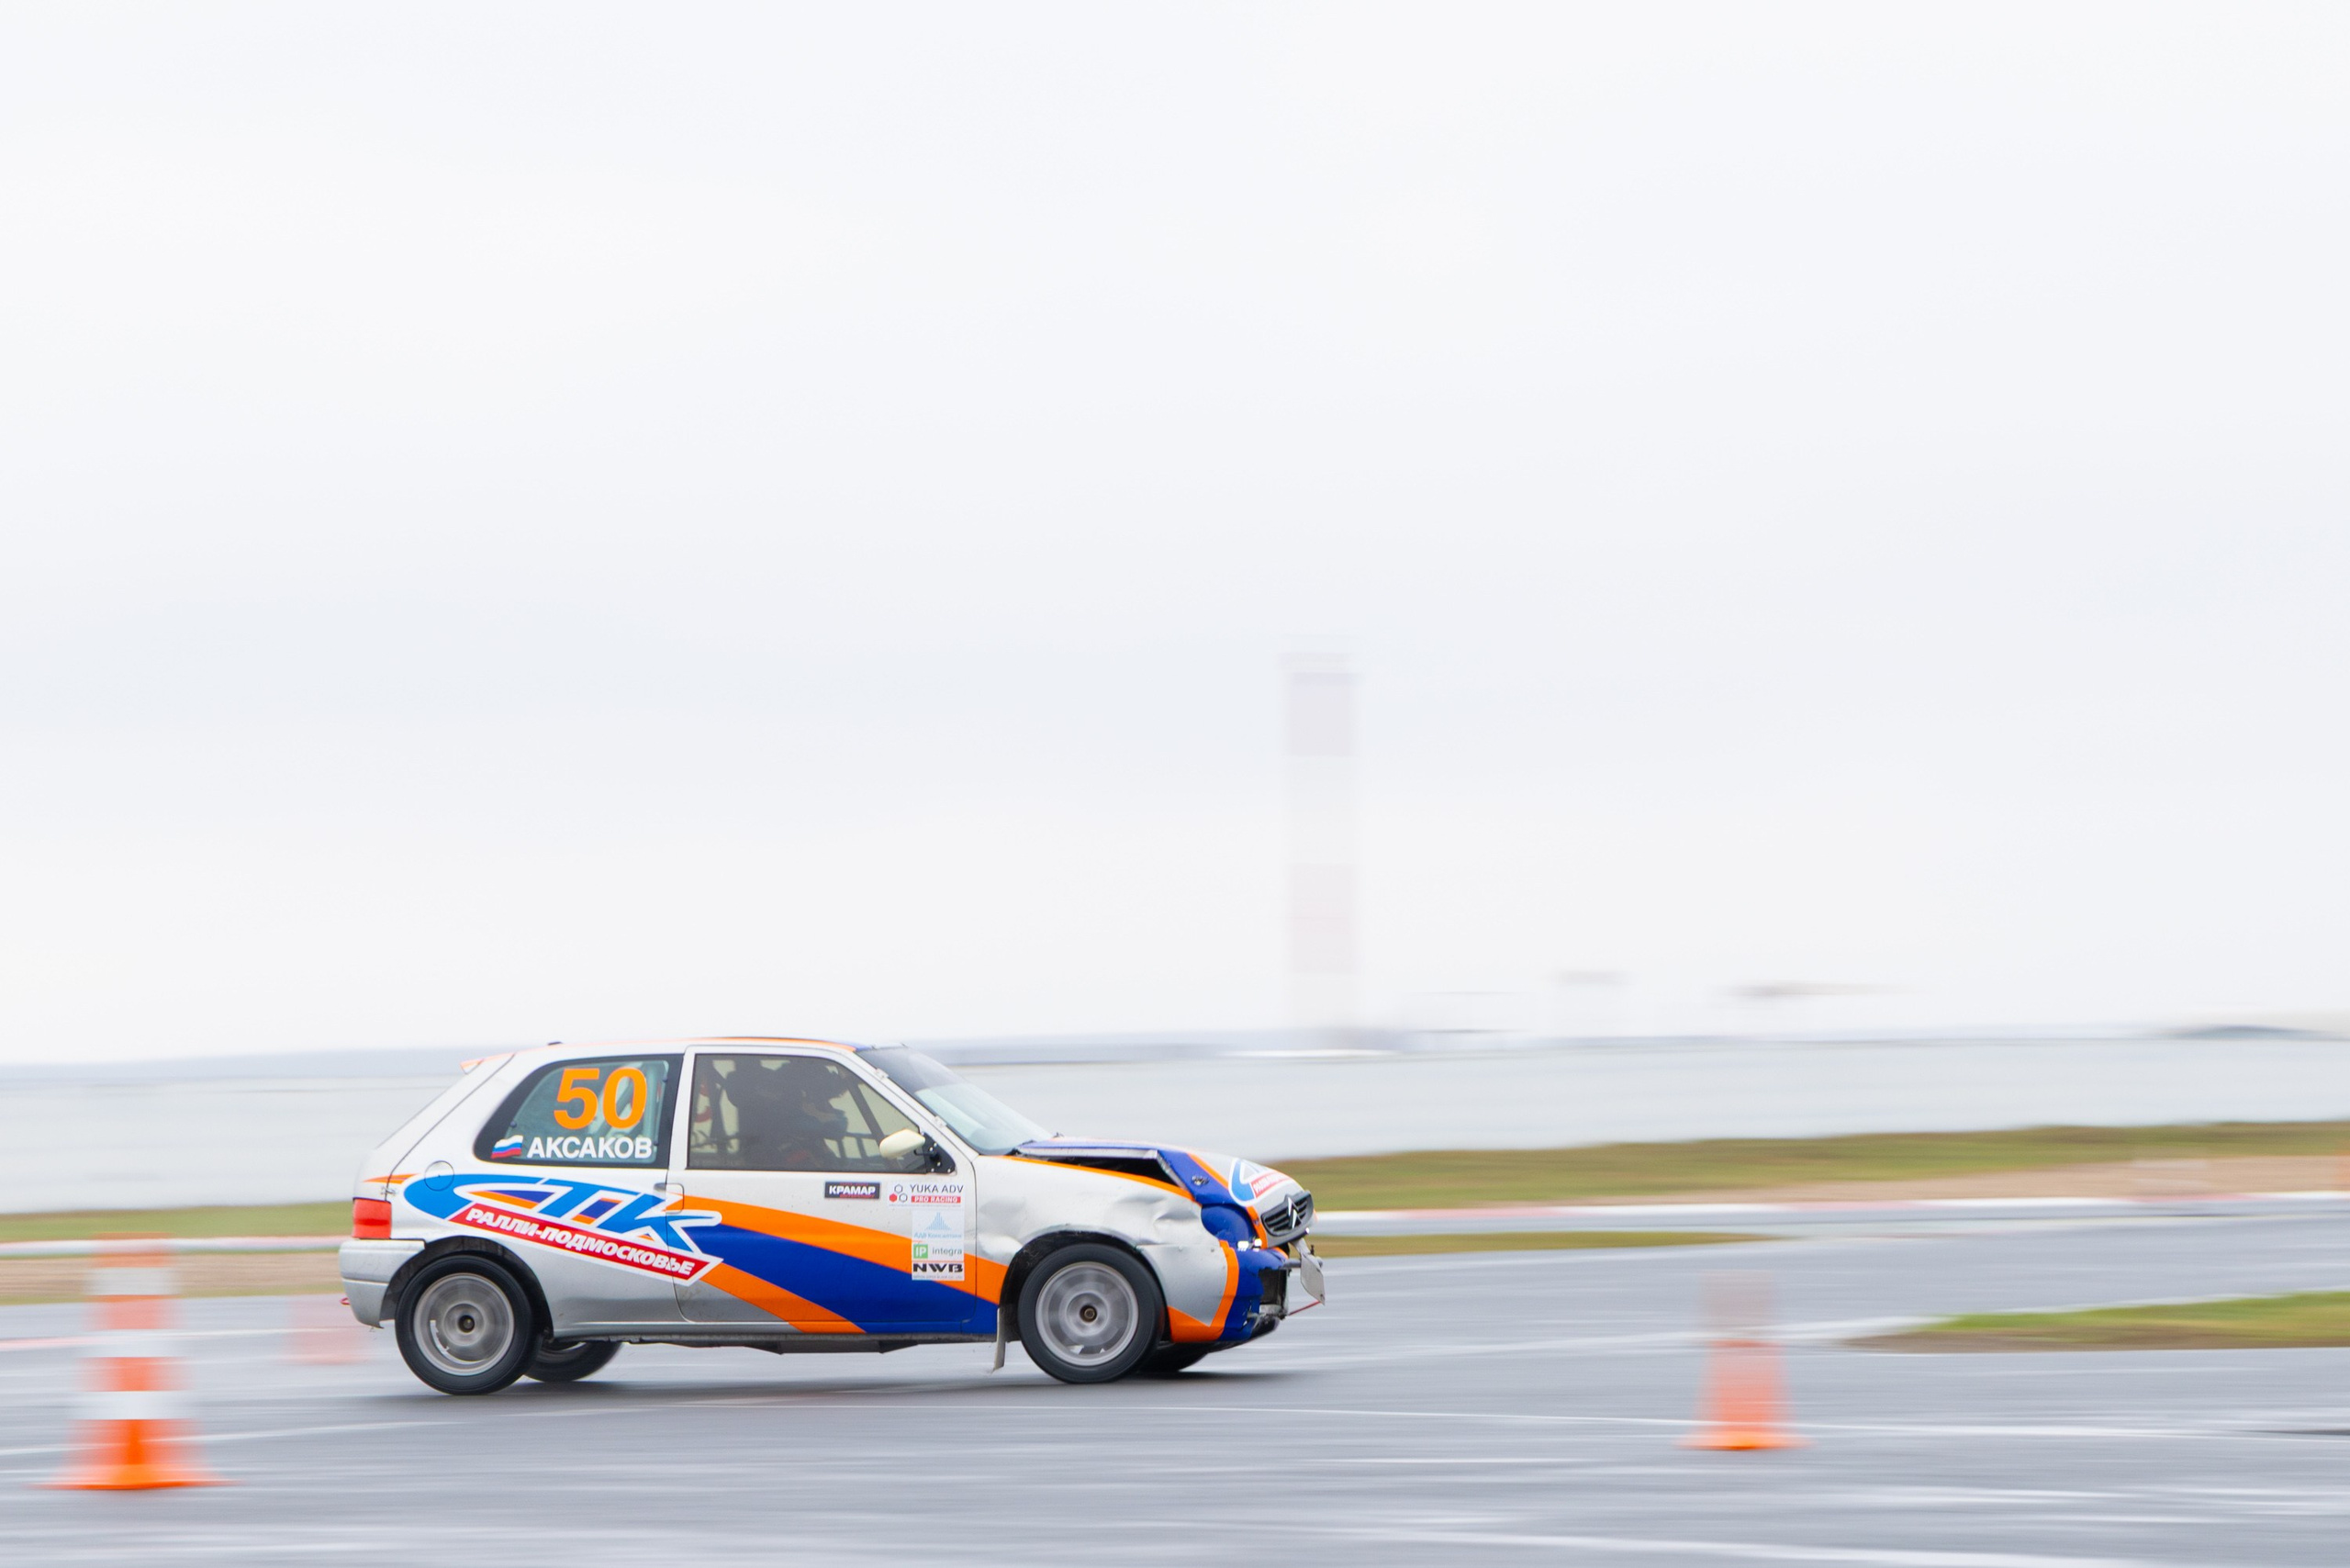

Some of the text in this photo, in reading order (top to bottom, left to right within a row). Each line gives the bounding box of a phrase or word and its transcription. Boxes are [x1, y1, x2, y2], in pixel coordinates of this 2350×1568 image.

[554, 1067, 647, 1129] 50
[527, 1137, 653, 1159] АКСАКОВ
[829, 1185, 876, 1195] КРАМАР
[910, 1184, 964, 1193] YUKA ADV
[465, 1207, 696, 1276] РАЛЛИ-ПОДМОСКОВЬЕ
[932, 1247, 962, 1256] integra
[912, 1263, 963, 1272] NWB
